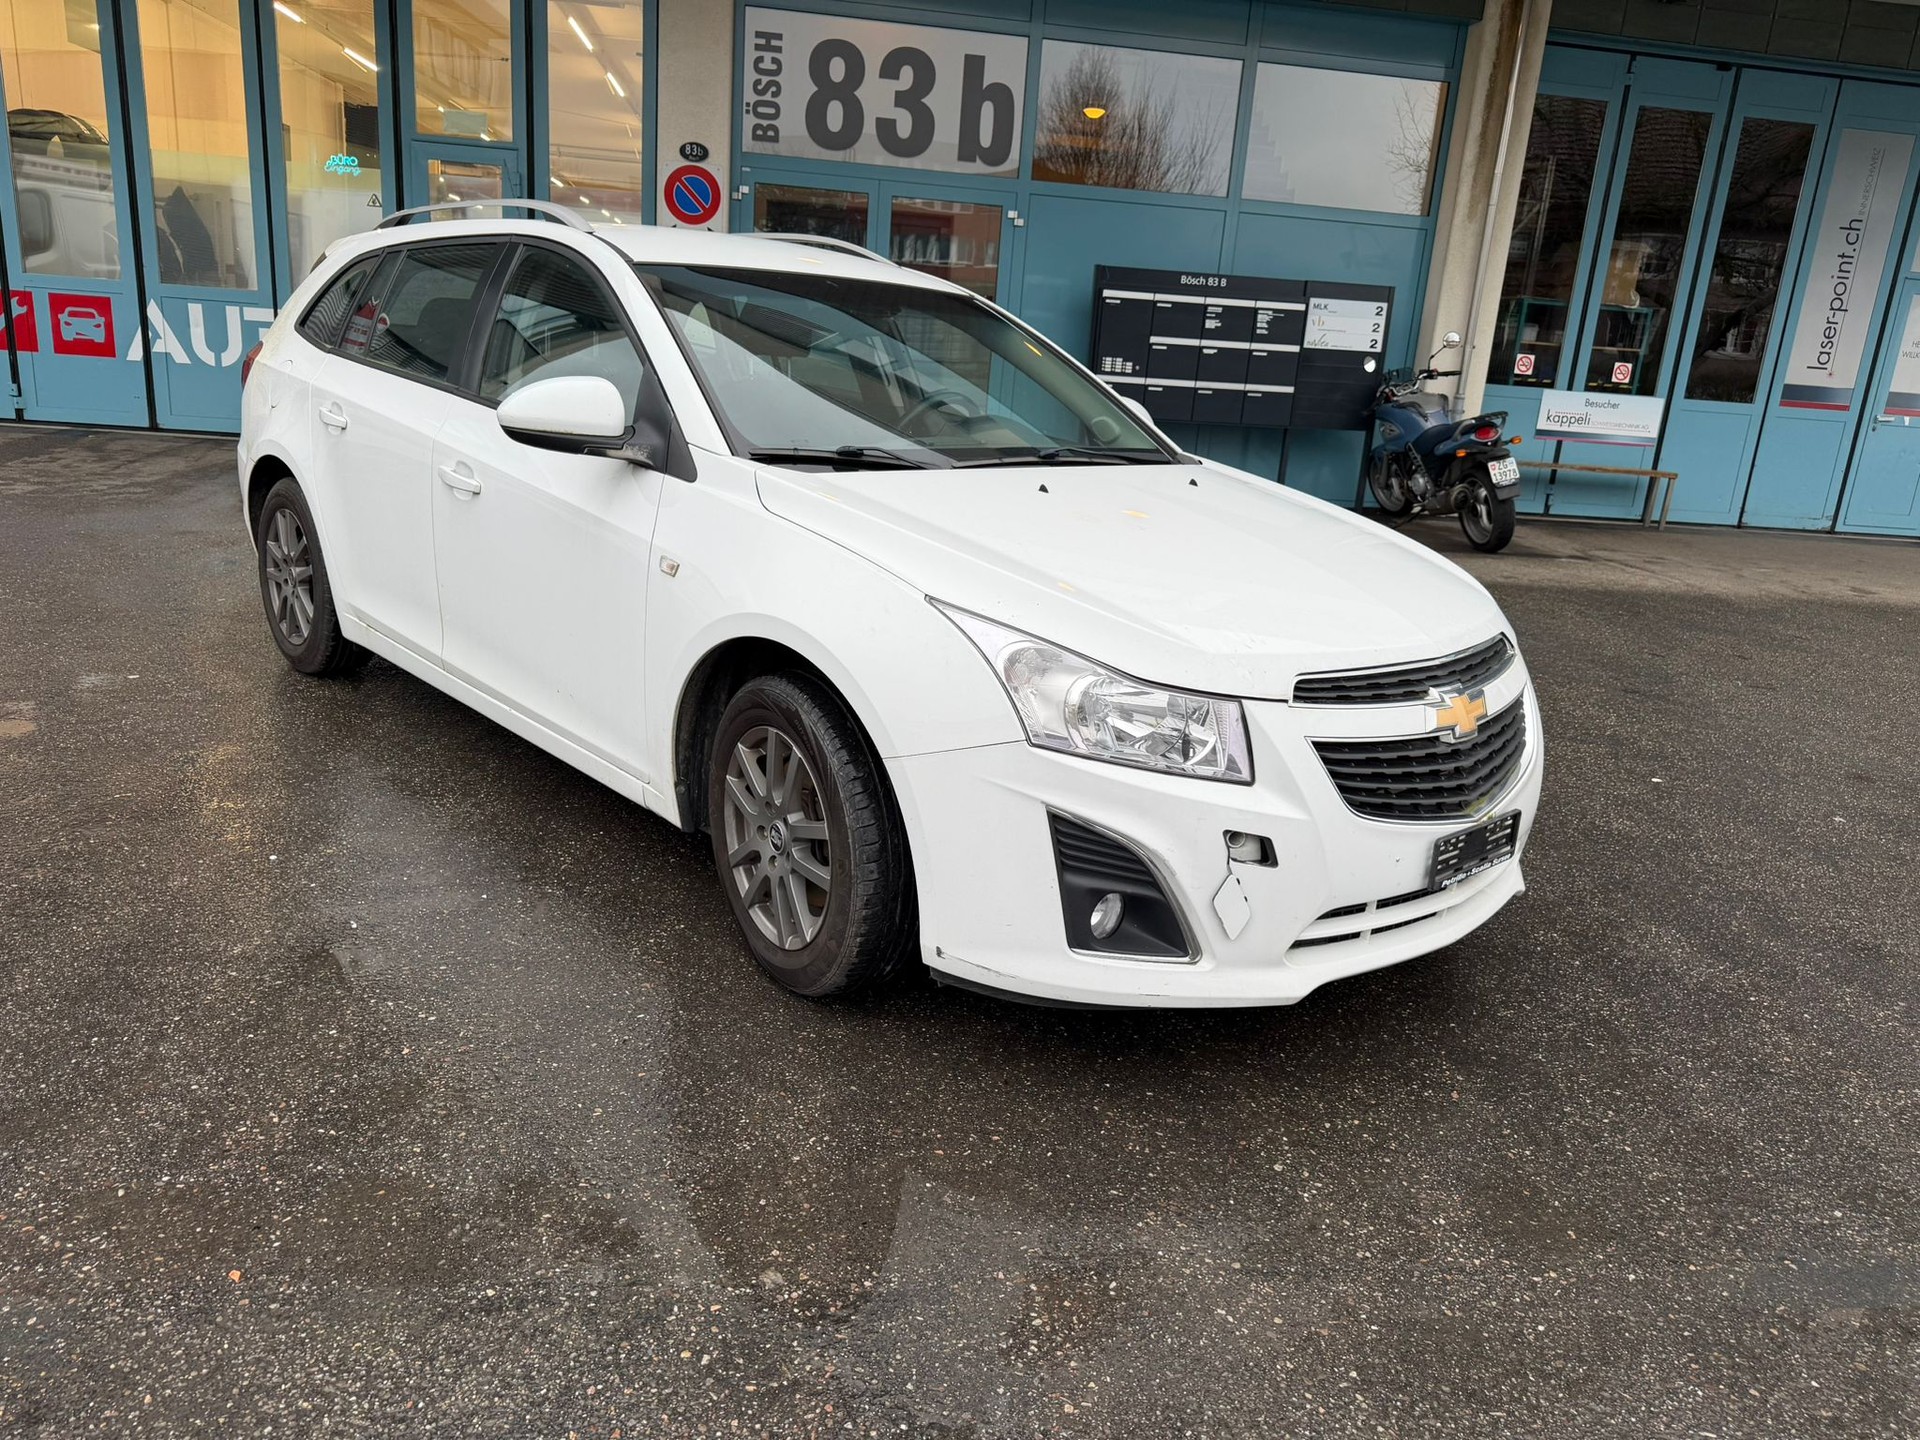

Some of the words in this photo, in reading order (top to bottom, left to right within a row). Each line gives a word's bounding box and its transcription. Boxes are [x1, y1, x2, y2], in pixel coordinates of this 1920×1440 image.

[745, 31, 783, 143] BÖSCH
[804, 38, 937, 158] 83
[685, 143, 704, 156] 83b
[330, 153, 358, 166] BÜRO
[1180, 275, 1206, 286] Bösch
[1207, 277, 1219, 287] 83
[1220, 279, 1227, 287] B
[1806, 218, 1863, 371] laser-point.ch
[1312, 303, 1330, 311] MLK
[1375, 306, 1384, 317] 2
[1371, 322, 1381, 333] 2
[1369, 338, 1378, 349] 2
[1584, 398, 1620, 409] Besucher
[1493, 468, 1518, 481] 13978
